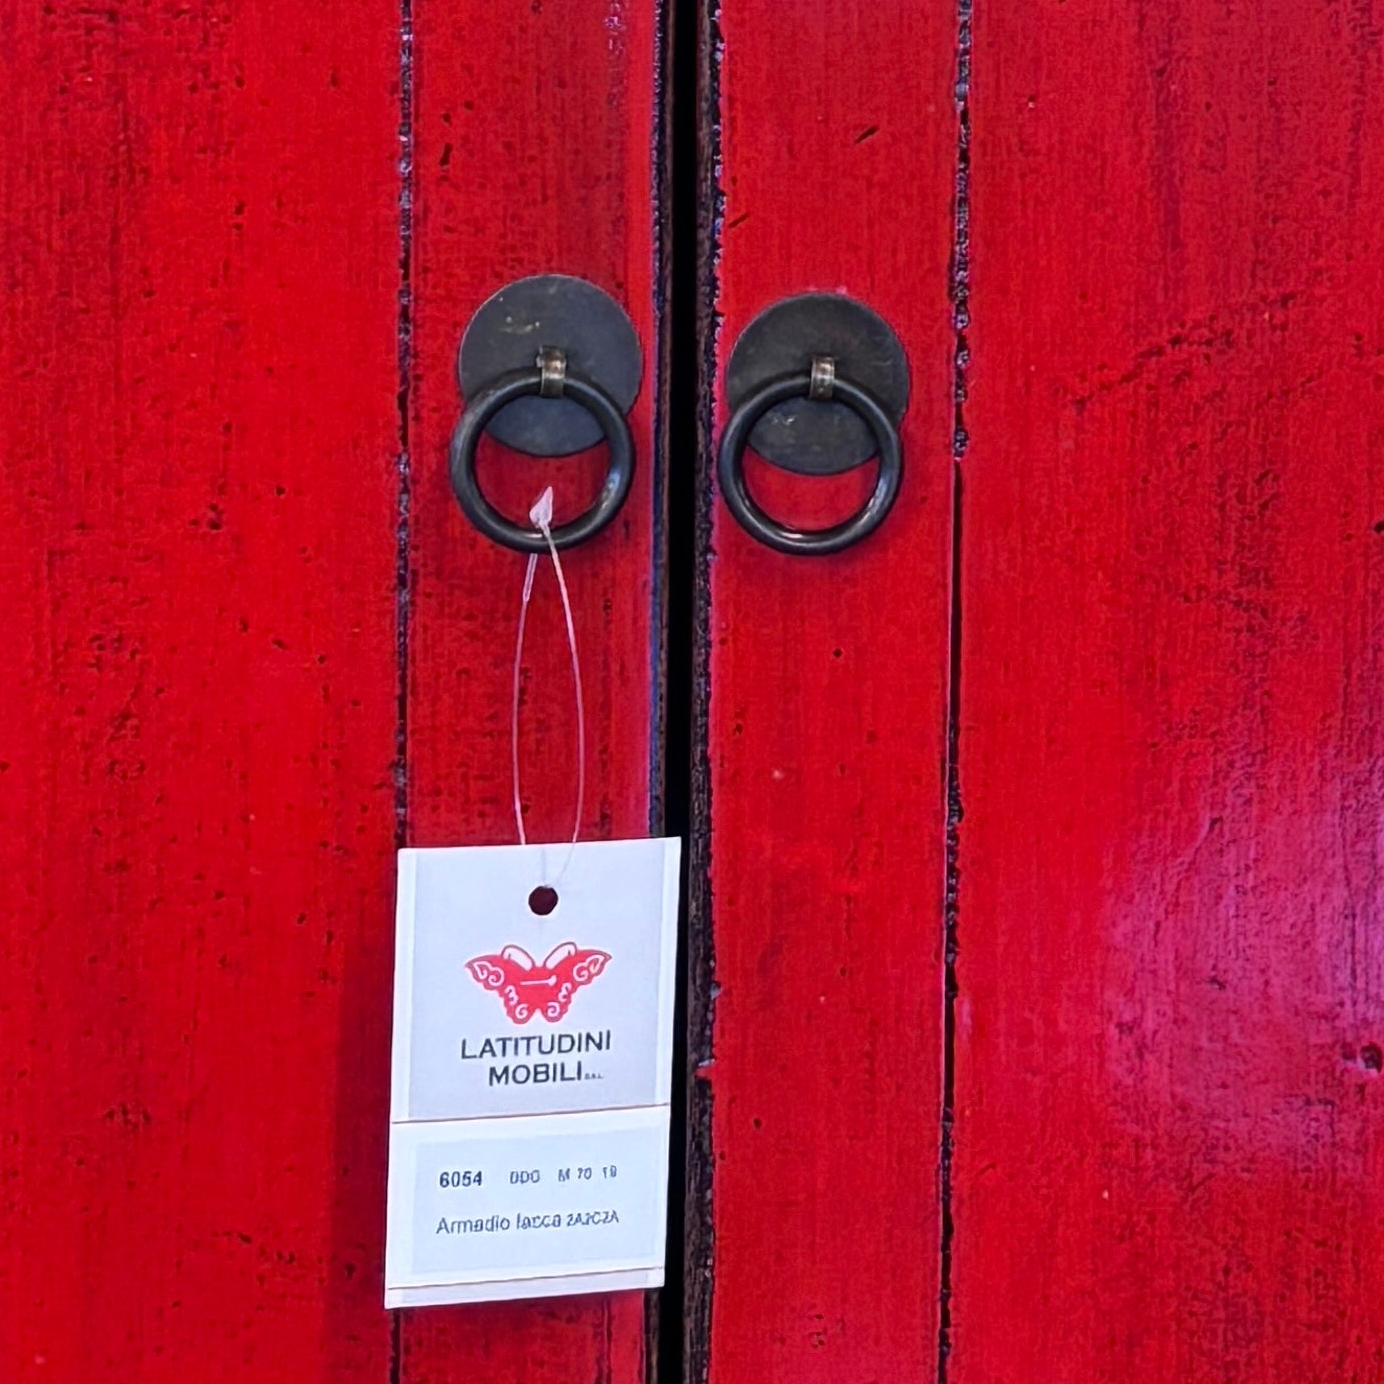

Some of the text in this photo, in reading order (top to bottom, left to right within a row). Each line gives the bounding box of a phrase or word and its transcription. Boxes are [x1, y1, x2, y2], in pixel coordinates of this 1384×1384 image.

[461, 1029, 611, 1059] LATITUDINI
[489, 1061, 582, 1086] MOBILI
[439, 1170, 484, 1188] 6054
[436, 1215, 511, 1235] Armadio
[517, 1213, 562, 1230] lacca
